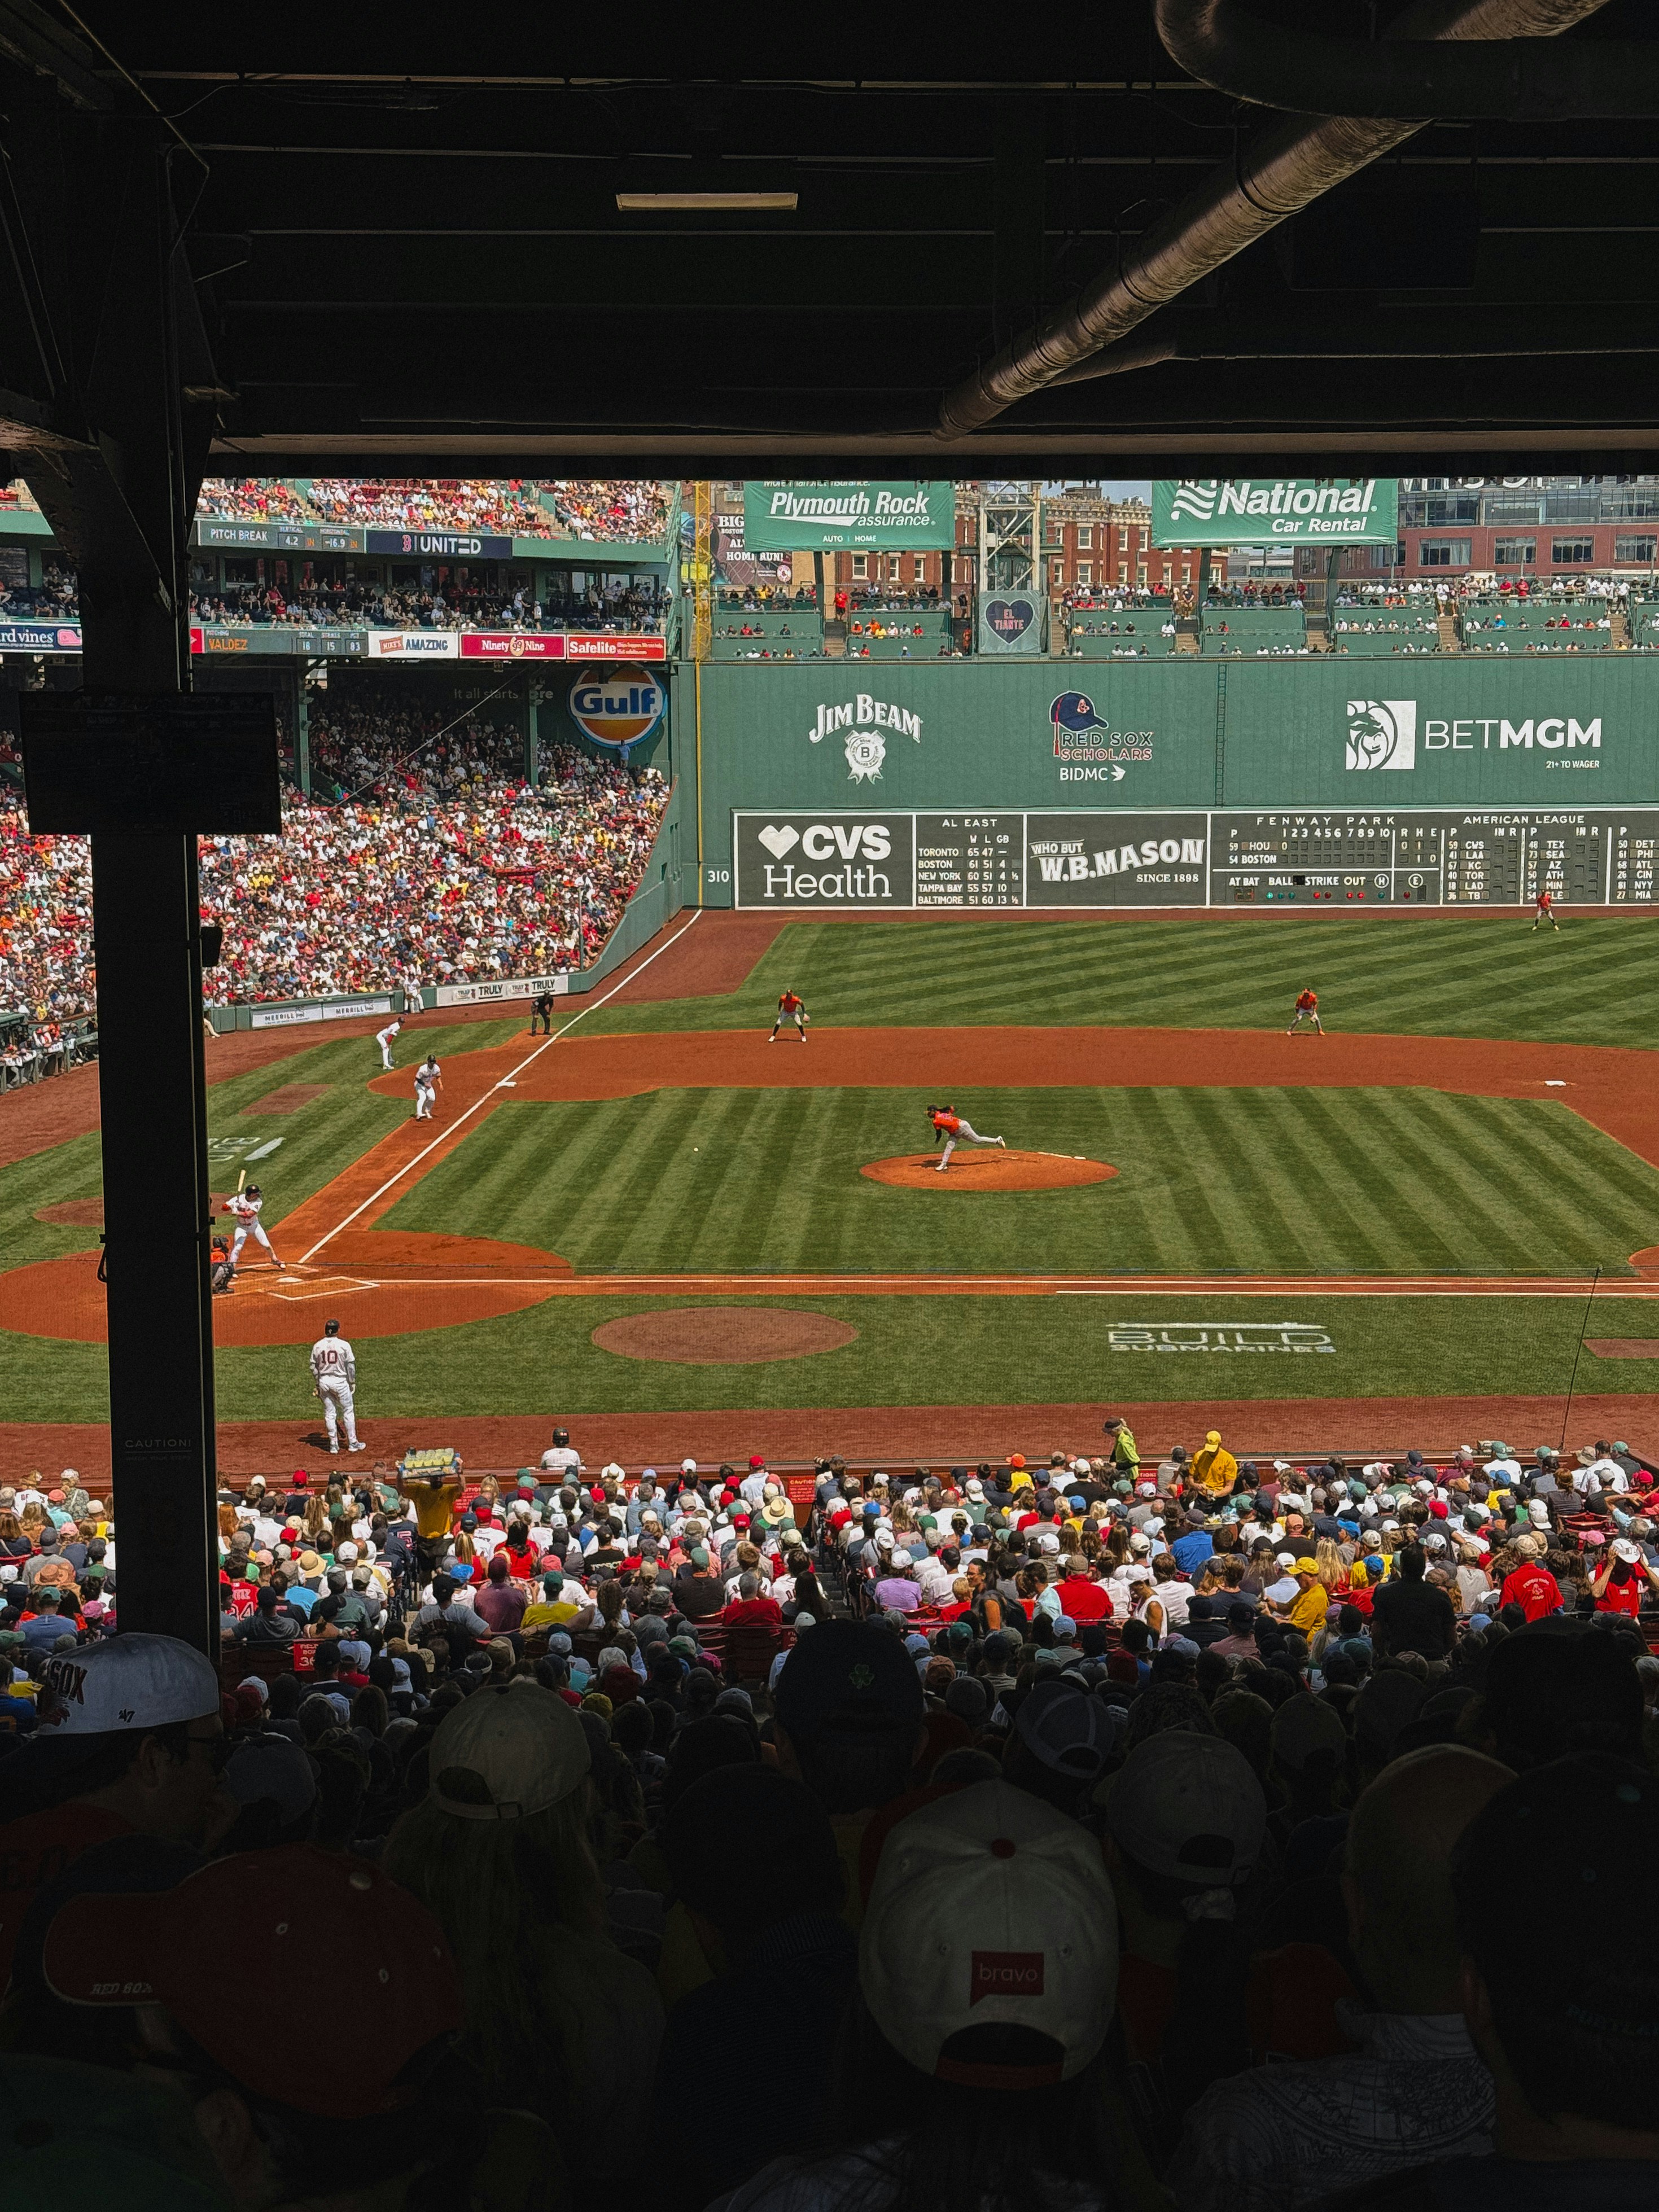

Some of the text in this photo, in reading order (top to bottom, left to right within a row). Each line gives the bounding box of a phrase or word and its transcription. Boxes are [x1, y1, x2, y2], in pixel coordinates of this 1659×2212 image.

[770, 491, 930, 516] Plymouth Rock
[717, 516, 745, 527] BIG
[1272, 517, 1367, 533] Car Rental
[210, 528, 268, 542] PITCH BREAK
[285, 536, 299, 546] 4.2
[420, 536, 481, 555] UNITED
[760, 552, 783, 562] RUN!
[1004, 609, 1014, 619] EL
[994, 619, 1025, 630] TIANTE
[17, 629, 54, 643] vines
[208, 638, 248, 651] VALDEZ
[302, 641, 310, 651] 18
[327, 641, 335, 651] 15
[405, 638, 448, 651] AMAZING
[481, 640, 545, 653] Ninety Nine
[569, 641, 616, 654] Safelite
[454, 687, 519, 699] It all starts
[574, 687, 657, 715] Gulf
[808, 693, 921, 744] JIM BEAM
[1424, 717, 1602, 750] BETMGM
[1061, 732, 1154, 747] RED SOX
[861, 747, 870, 758] B
[1061, 748, 1153, 761] SCHOLARS
[1545, 760, 1600, 769] 21+ TO WAGER
[1060, 767, 1109, 781] BIDMC
[942, 818, 998, 827] AL EAST
[1257, 816, 1395, 826] FENWAY PARK
[1463, 815, 1584, 824] AMERICAN LEAGUE
[1231, 827, 1437, 838] P 1 2 3 4 5 6 7 8 9 10 R H E
[1450, 826, 1627, 836] P IN R P IN R P
[802, 825, 891, 860] CVS
[970, 834, 1009, 844] W L GB
[1448, 839, 1655, 849] 59 CWS TEX DET
[1030, 842, 1083, 855] WHO BUT
[1229, 841, 1408, 851] 59 HOU 0 0
[918, 847, 993, 857] TORONTO 65 47
[1449, 849, 1653, 860] 41 LAA SEA 61 PHI
[918, 859, 1005, 869] BOSTON 61 51 4
[1039, 838, 1205, 882] W.B.MASON
[1241, 854, 1437, 864] BOSTON 0
[1448, 860, 1654, 870] 67 KC 57 AZ ATL
[707, 870, 729, 883] 310
[918, 871, 1006, 881] NEW YORK 60 51 4
[1136, 873, 1199, 883] SINCE 1898
[1447, 870, 1653, 880] 40 TOR 50 ATH 26 CIN
[763, 865, 892, 898] Health
[1229, 876, 1366, 886] AT BAT BALL STRIKE OUT
[1448, 881, 1653, 890] 18 LAD MIN 81 NYY
[918, 883, 1007, 893] TAMPA BAY 55 57 10
[918, 895, 1007, 905] BALTIMORE 51 60 13
[1447, 890, 1652, 900] 36 TB MIA
[479, 984, 503, 996] TRULY
[532, 979, 555, 991] TRULY
[335, 1006, 364, 1015] MERRILL
[265, 1013, 294, 1022] MERRILL
[1108, 1331, 1331, 1346] BUILD
[1110, 1344, 1337, 1353] SUBMARINES
[321, 1350, 338, 1364] 10
[979, 1963, 1038, 1982] bravo
